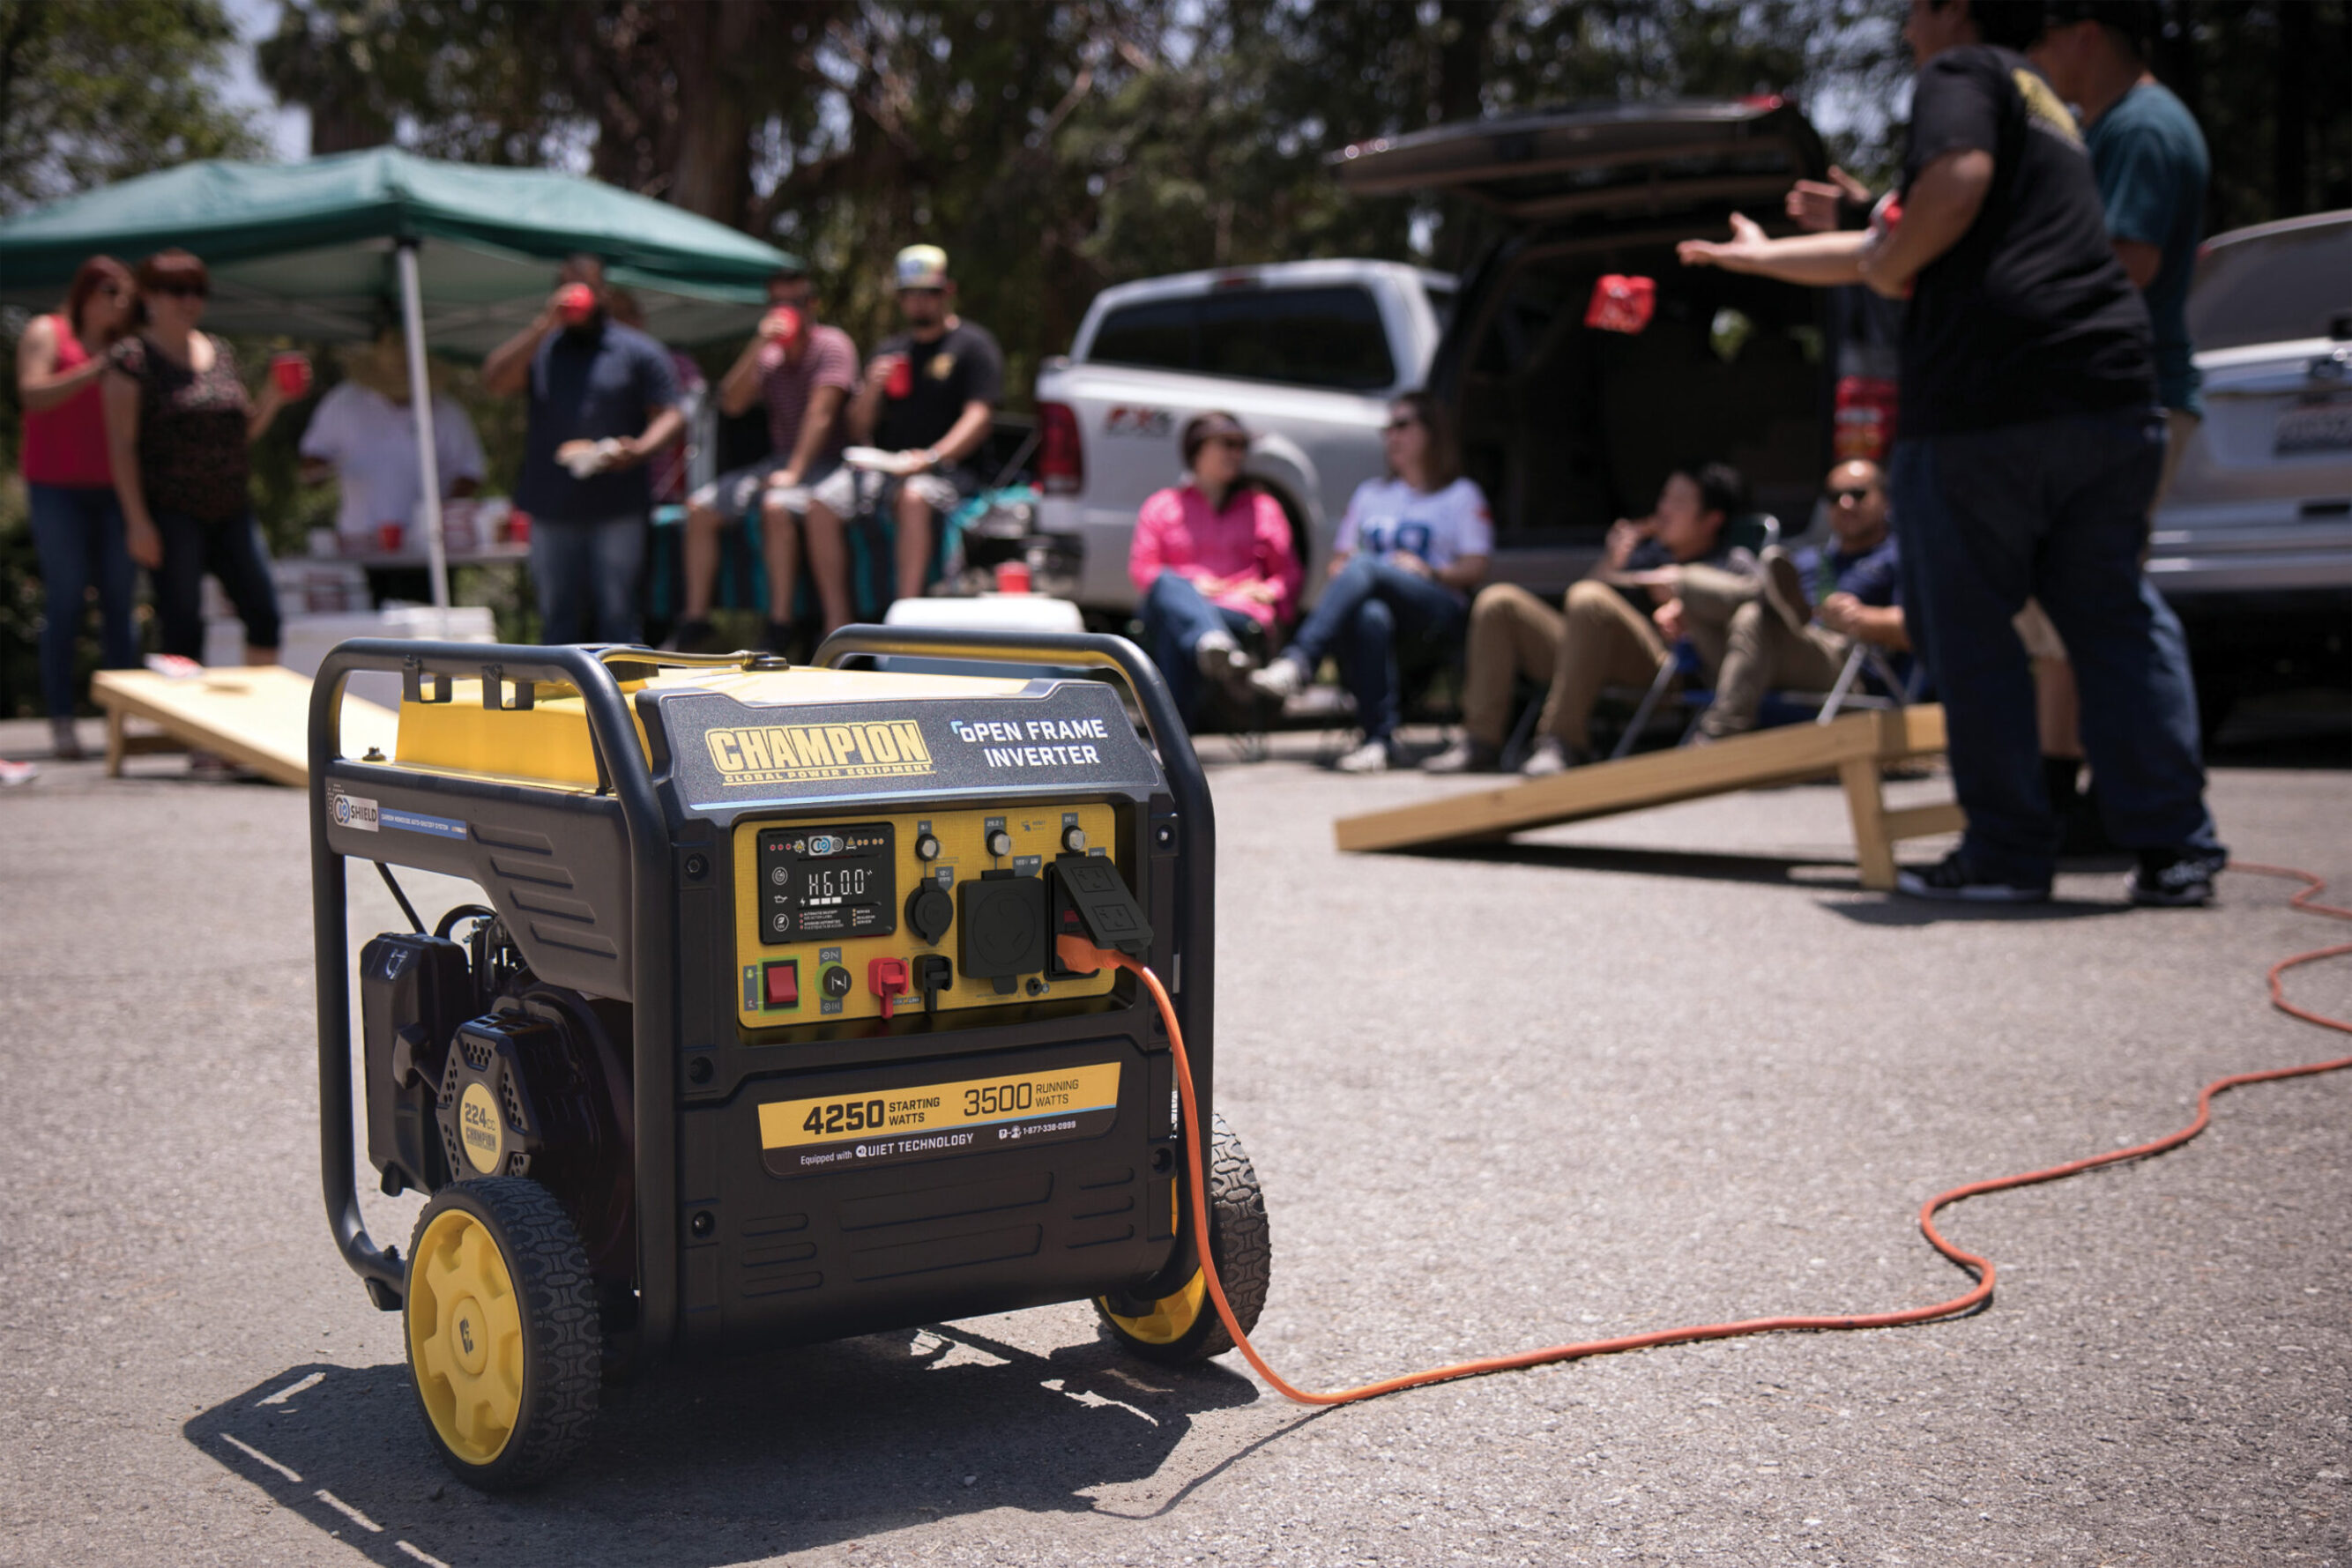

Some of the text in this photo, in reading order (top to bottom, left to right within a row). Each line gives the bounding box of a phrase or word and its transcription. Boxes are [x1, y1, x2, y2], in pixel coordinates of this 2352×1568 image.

[960, 718, 1108, 743] OPEN FRAME
[708, 722, 928, 772] CHAMPION
[985, 744, 1101, 769] INVERTER
[725, 764, 931, 783] GLOBAL POWER EQUIPMENT
[351, 805, 377, 822] SHIELD
[803, 1079, 1080, 1135] 4250 STARTING 3500 RUNNING
[889, 1093, 1069, 1126] WATTS WATTS
[800, 1133, 975, 1166] Equipped with QUIET TECHNOLOGY
